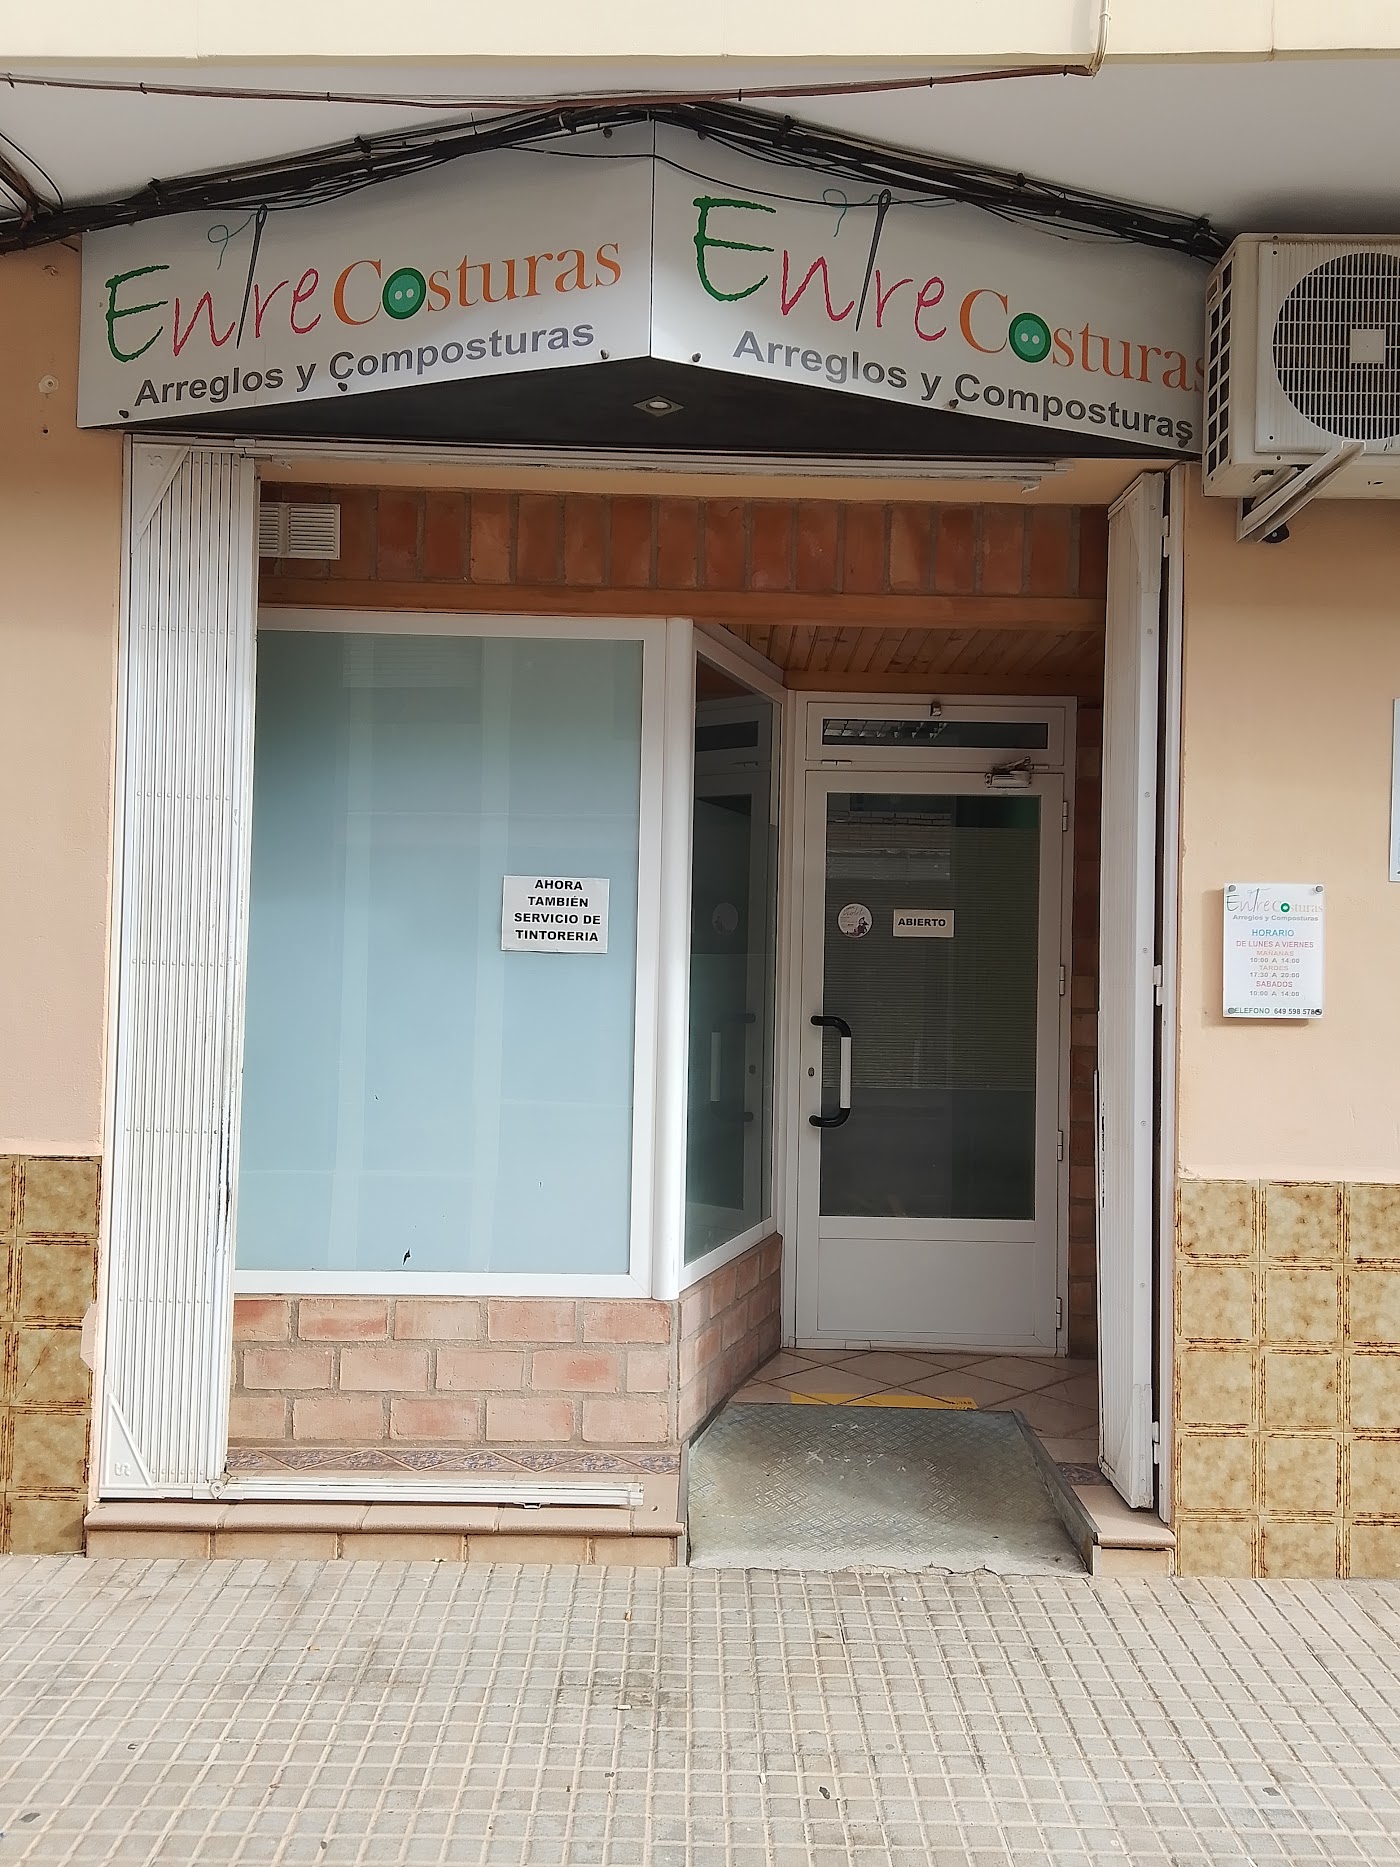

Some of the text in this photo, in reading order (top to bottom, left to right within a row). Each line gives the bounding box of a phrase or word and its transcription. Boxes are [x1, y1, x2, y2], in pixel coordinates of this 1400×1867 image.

[333, 241, 622, 327] Costuras
[134, 323, 595, 406] Arreglos y Composturas
[732, 330, 1193, 441] Arreglos y Composturas
[535, 879, 583, 890] AHORA
[527, 895, 588, 908] TAMBIÉN
[514, 912, 601, 925] SERVICIO DE
[897, 917, 946, 927] ABIERTO
[1232, 914, 1264, 922] Arreglos
[1271, 914, 1319, 922] Composturas
[515, 929, 599, 941] TINTORERIA
[1251, 929, 1295, 937] HORARIO
[1248, 940, 1274, 948] LUNES
[1256, 980, 1293, 988] SABADOS
